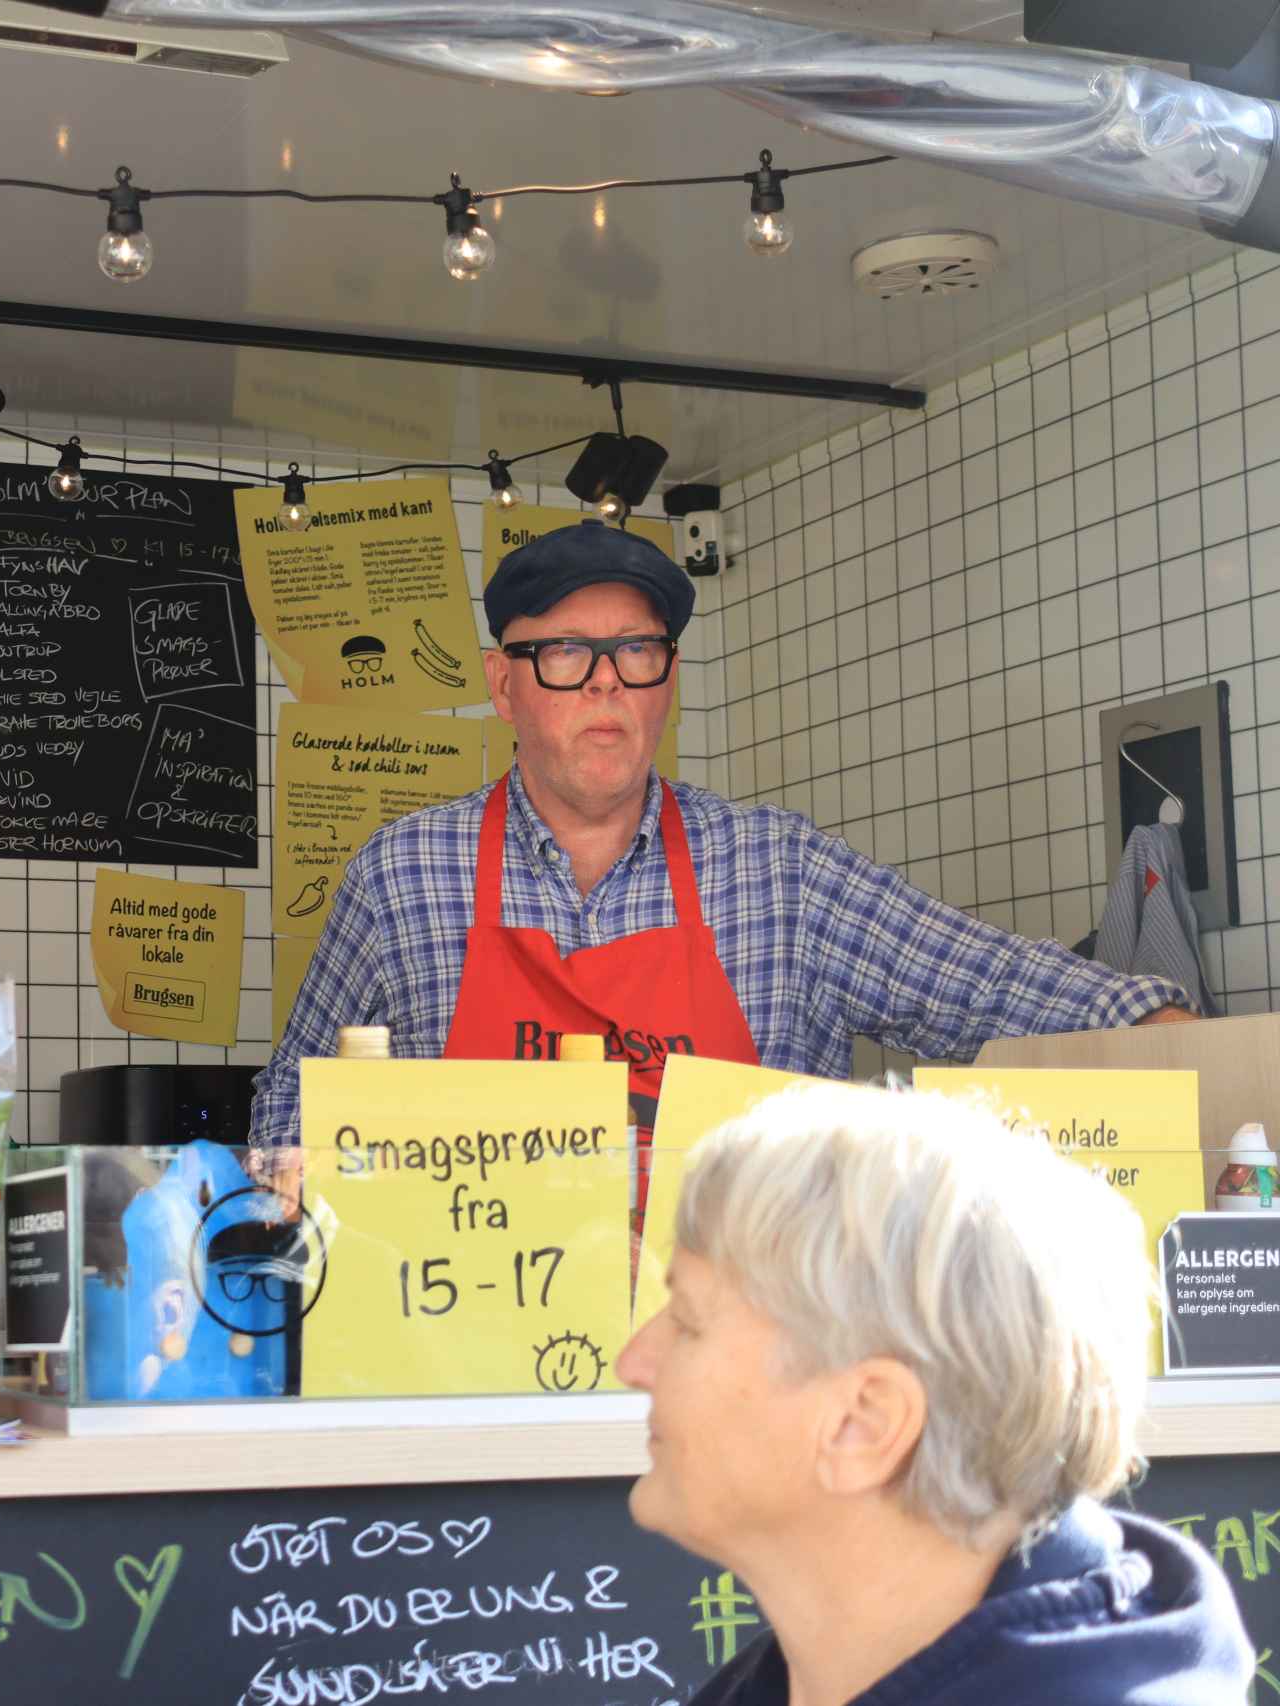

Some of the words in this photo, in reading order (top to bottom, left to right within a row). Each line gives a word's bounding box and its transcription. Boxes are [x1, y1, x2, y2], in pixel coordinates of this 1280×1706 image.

[305, 507, 366, 532] ølsemix
[368, 502, 398, 520] med
[402, 499, 434, 517] kant
[341, 674, 395, 690] HOLM
[291, 731, 353, 749] Glaserede
[354, 733, 413, 754] kødboller
[422, 743, 461, 756] sesam
[330, 754, 344, 773] &
[348, 756, 370, 774] sød
[373, 758, 402, 775] chili
[404, 762, 429, 776] sovs
[110, 897, 145, 916] Altid
[148, 901, 179, 919] med
[182, 903, 217, 924] gode
[108, 923, 163, 941] råvarer
[167, 923, 189, 942] fra
[192, 925, 215, 942] din
[142, 944, 185, 963] lokale
[133, 983, 195, 1008] Brugsen
[334, 1124, 608, 1182] Smagsprøver
[448, 1183, 509, 1232] fra
[1176, 1250, 1280, 1268] ALLERGEN
[1176, 1272, 1237, 1284] Personalet
[1176, 1288, 1198, 1299] kan
[1199, 1287, 1235, 1301] oplyse
[1236, 1289, 1255, 1298] om
[1177, 1302, 1228, 1317] allergene
[352, 1518, 434, 1558] OS
[230, 1592, 336, 1638] NÅR
[337, 1593, 397, 1635] DU
[408, 1588, 468, 1626] ER
[585, 1565, 628, 1610] &
[578, 1631, 675, 1687] HER
